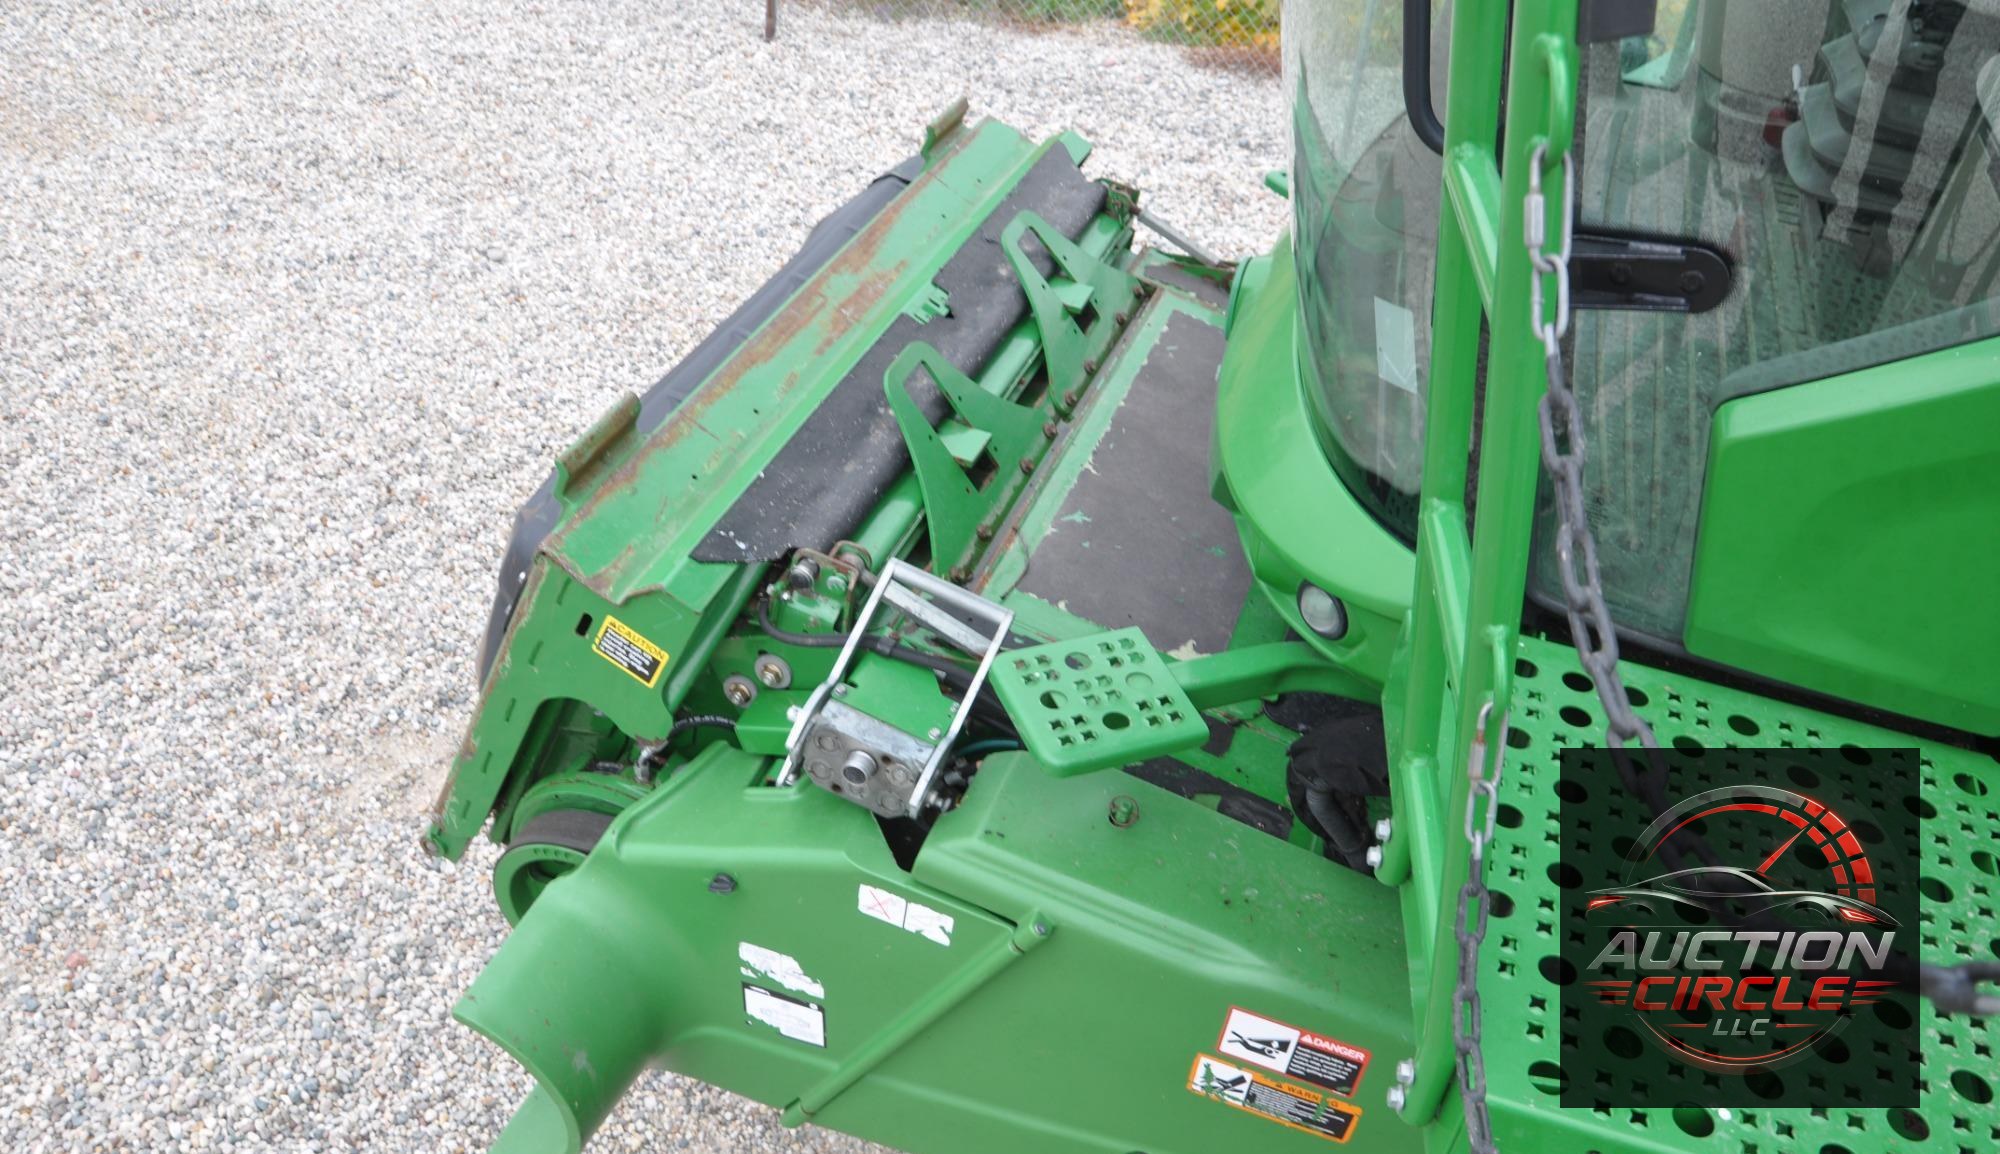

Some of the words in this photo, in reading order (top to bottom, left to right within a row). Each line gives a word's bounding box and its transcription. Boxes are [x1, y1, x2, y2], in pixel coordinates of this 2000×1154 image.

[617, 624, 663, 659] CAUTION
[1312, 1037, 1366, 1062] DANGER
[1287, 1085, 1339, 1108] WARNG
